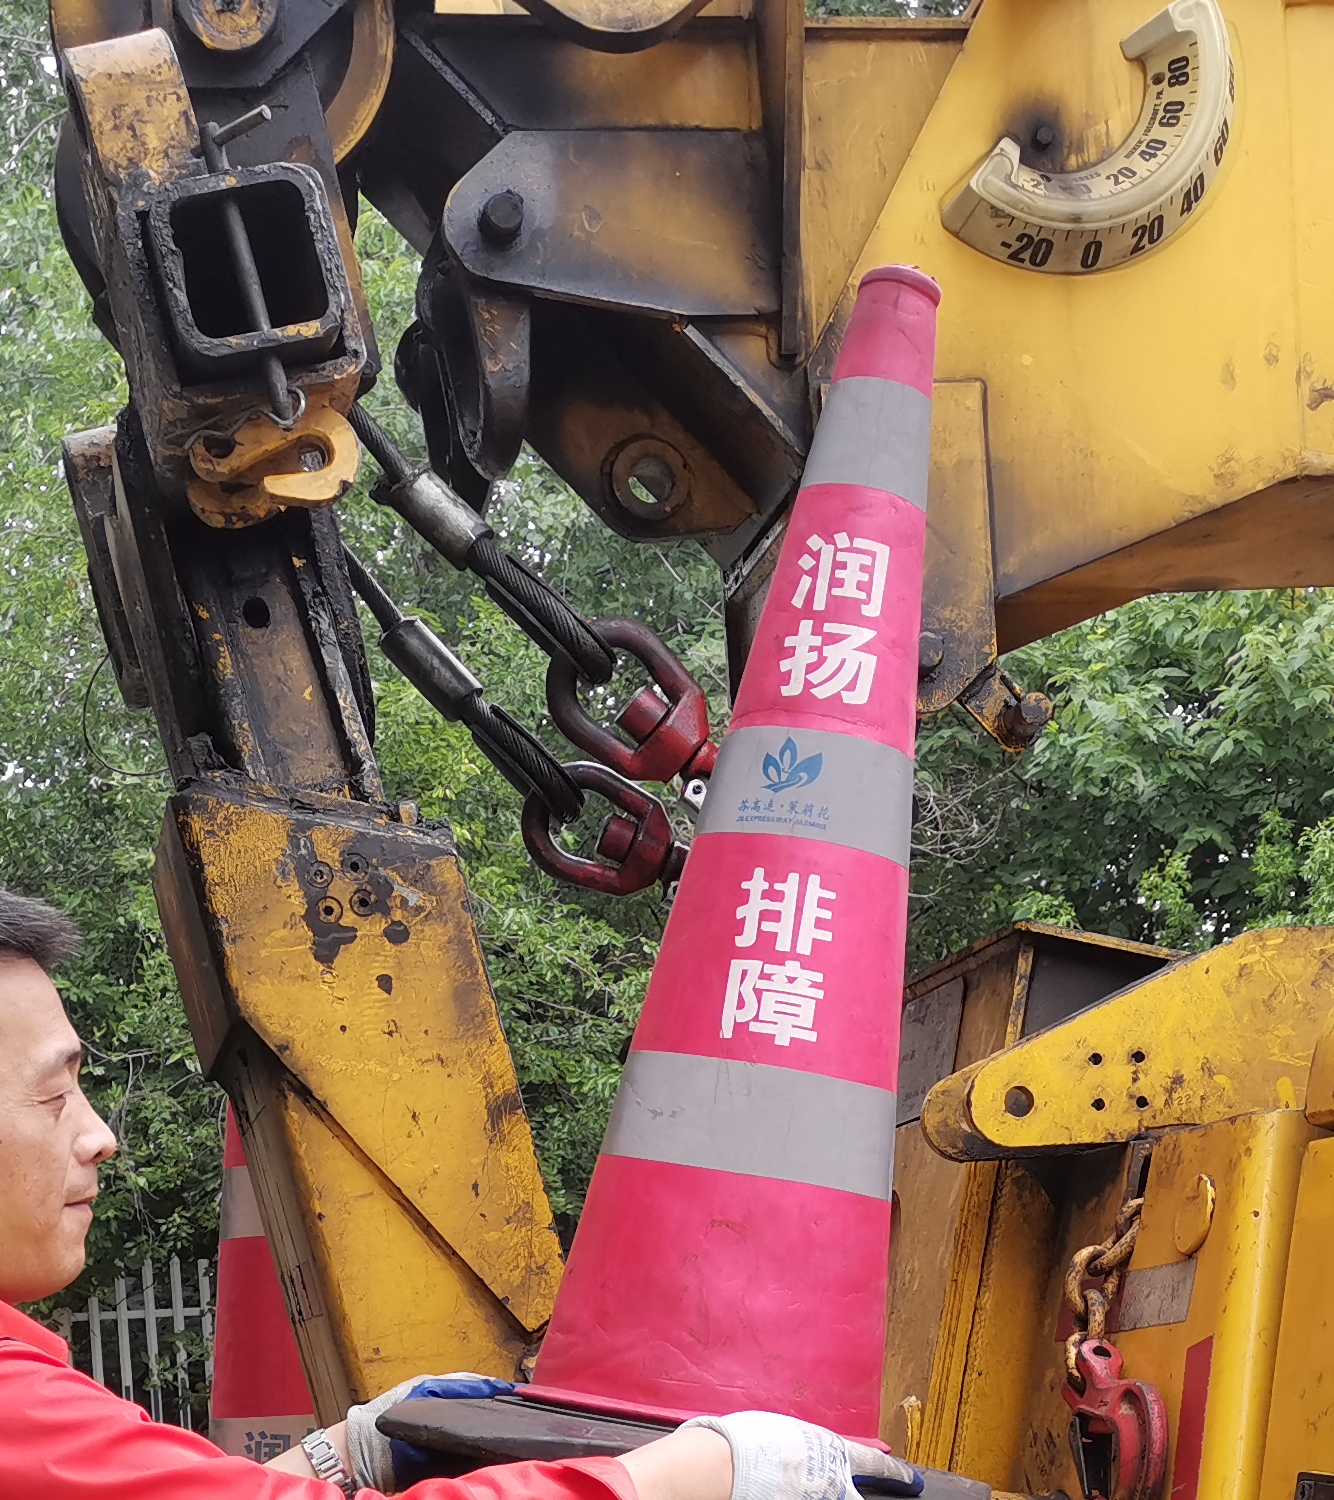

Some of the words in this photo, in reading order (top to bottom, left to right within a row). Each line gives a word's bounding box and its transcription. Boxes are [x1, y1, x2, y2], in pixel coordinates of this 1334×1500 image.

[1167, 55, 1190, 88] 80
[1158, 100, 1186, 128] 60
[1138, 138, 1168, 163] 40
[1000, 232, 1055, 269] -20
[1080, 240, 1103, 269] 0
[1129, 214, 1165, 257] 20
[1179, 171, 1205, 218] 40
[1213, 116, 1230, 168] 60
[1105, 166, 1138, 187] 20
[779, 531, 891, 706] 润扬
[719, 866, 837, 1047] 排障
